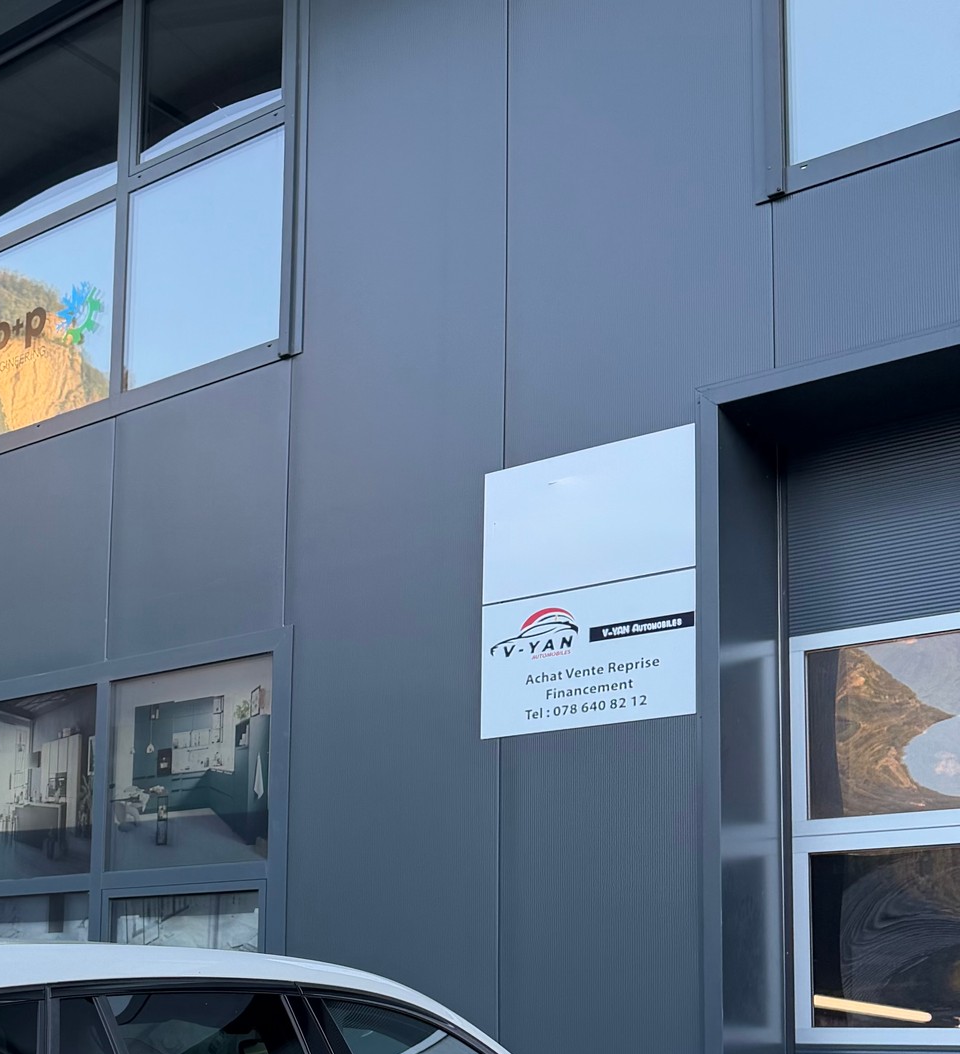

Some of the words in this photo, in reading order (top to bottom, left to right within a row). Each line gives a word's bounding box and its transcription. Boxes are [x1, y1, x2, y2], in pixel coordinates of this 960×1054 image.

[602, 624, 630, 637] V-YAN
[504, 635, 573, 658] V-YAN
[531, 649, 571, 660] AUTOMOBILES
[525, 671, 562, 685] Achat
[566, 666, 604, 679] Vente
[608, 657, 660, 674] Reprise
[546, 679, 633, 700] Financement
[525, 707, 543, 720] Tel
[553, 704, 577, 716] 078
[581, 700, 606, 713] 640
[610, 697, 626, 709] 82
[631, 694, 647, 706] 12
